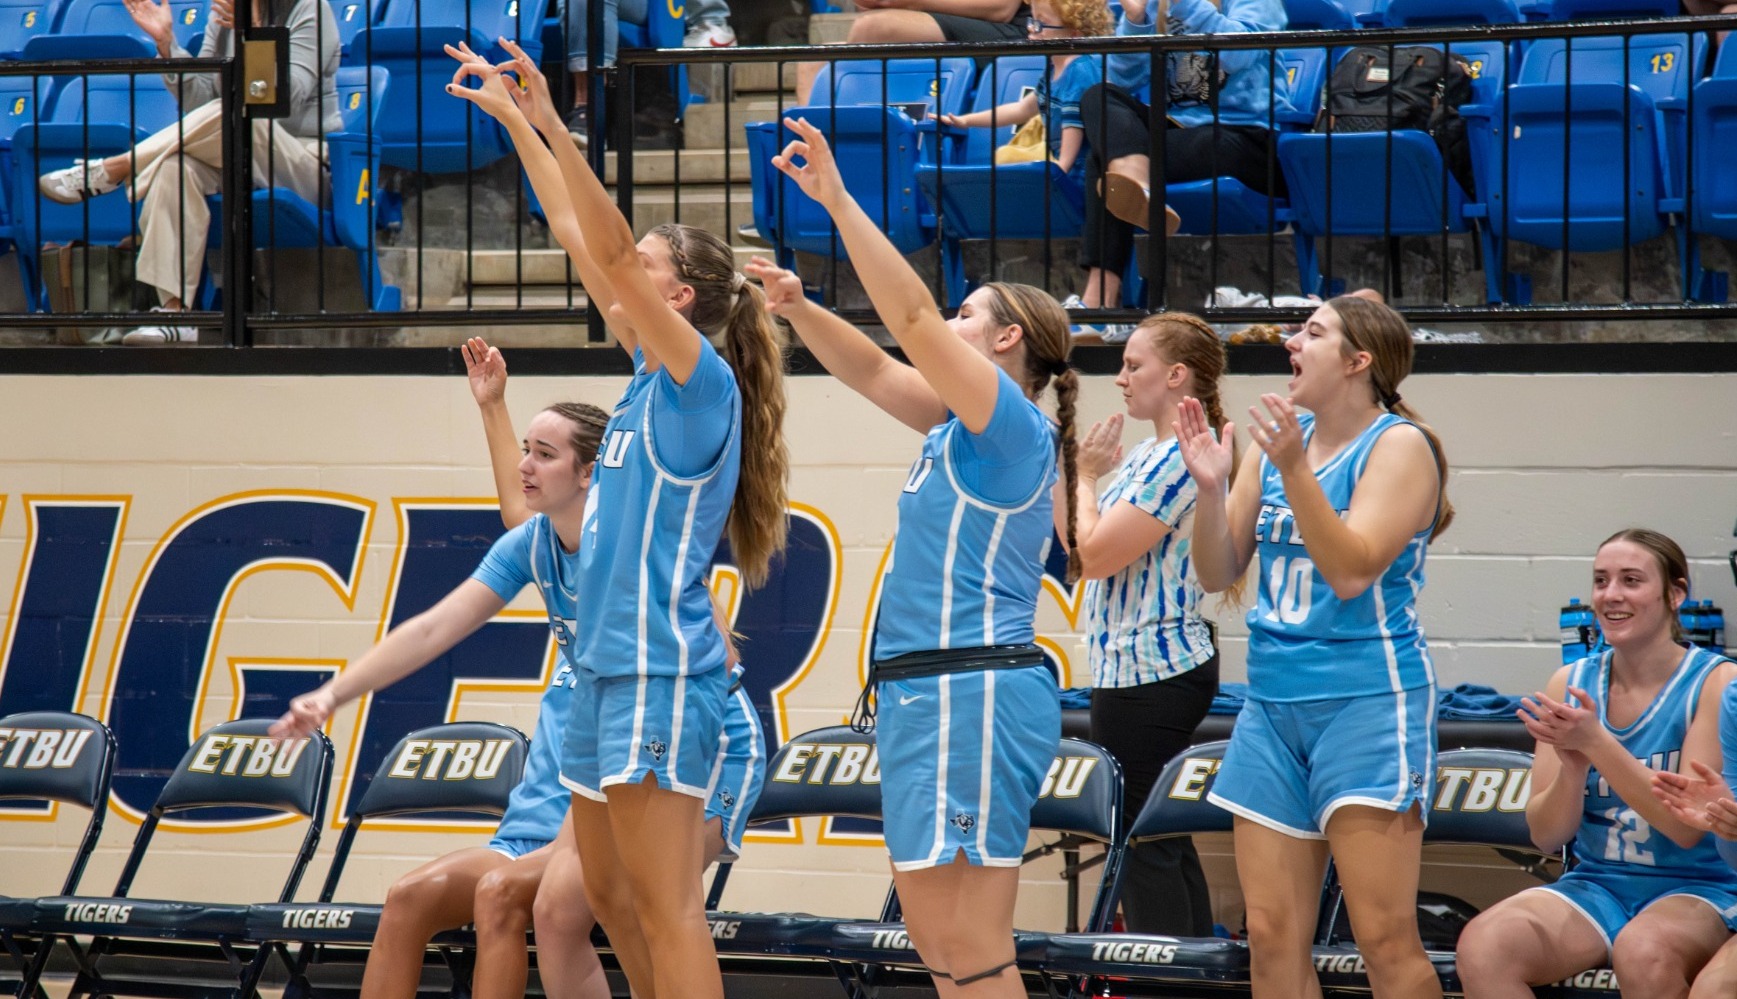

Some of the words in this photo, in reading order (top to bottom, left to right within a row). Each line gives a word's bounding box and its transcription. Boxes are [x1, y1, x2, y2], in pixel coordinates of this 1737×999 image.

[25, 11, 37, 28] 5
[185, 9, 198, 25] 6
[345, 5, 358, 22] 7
[1651, 53, 1675, 74] 13
[14, 98, 25, 115] 6
[350, 92, 361, 110] 8
[1264, 556, 1314, 625] 10
[188, 734, 311, 778] ETBU
[388, 739, 516, 782] ETBU
[1435, 767, 1532, 812] TBU
[1604, 807, 1656, 867] 12
[64, 902, 132, 925] TIGERS
[281, 908, 354, 929] TIGERS
[1092, 941, 1179, 964] TIGERS
